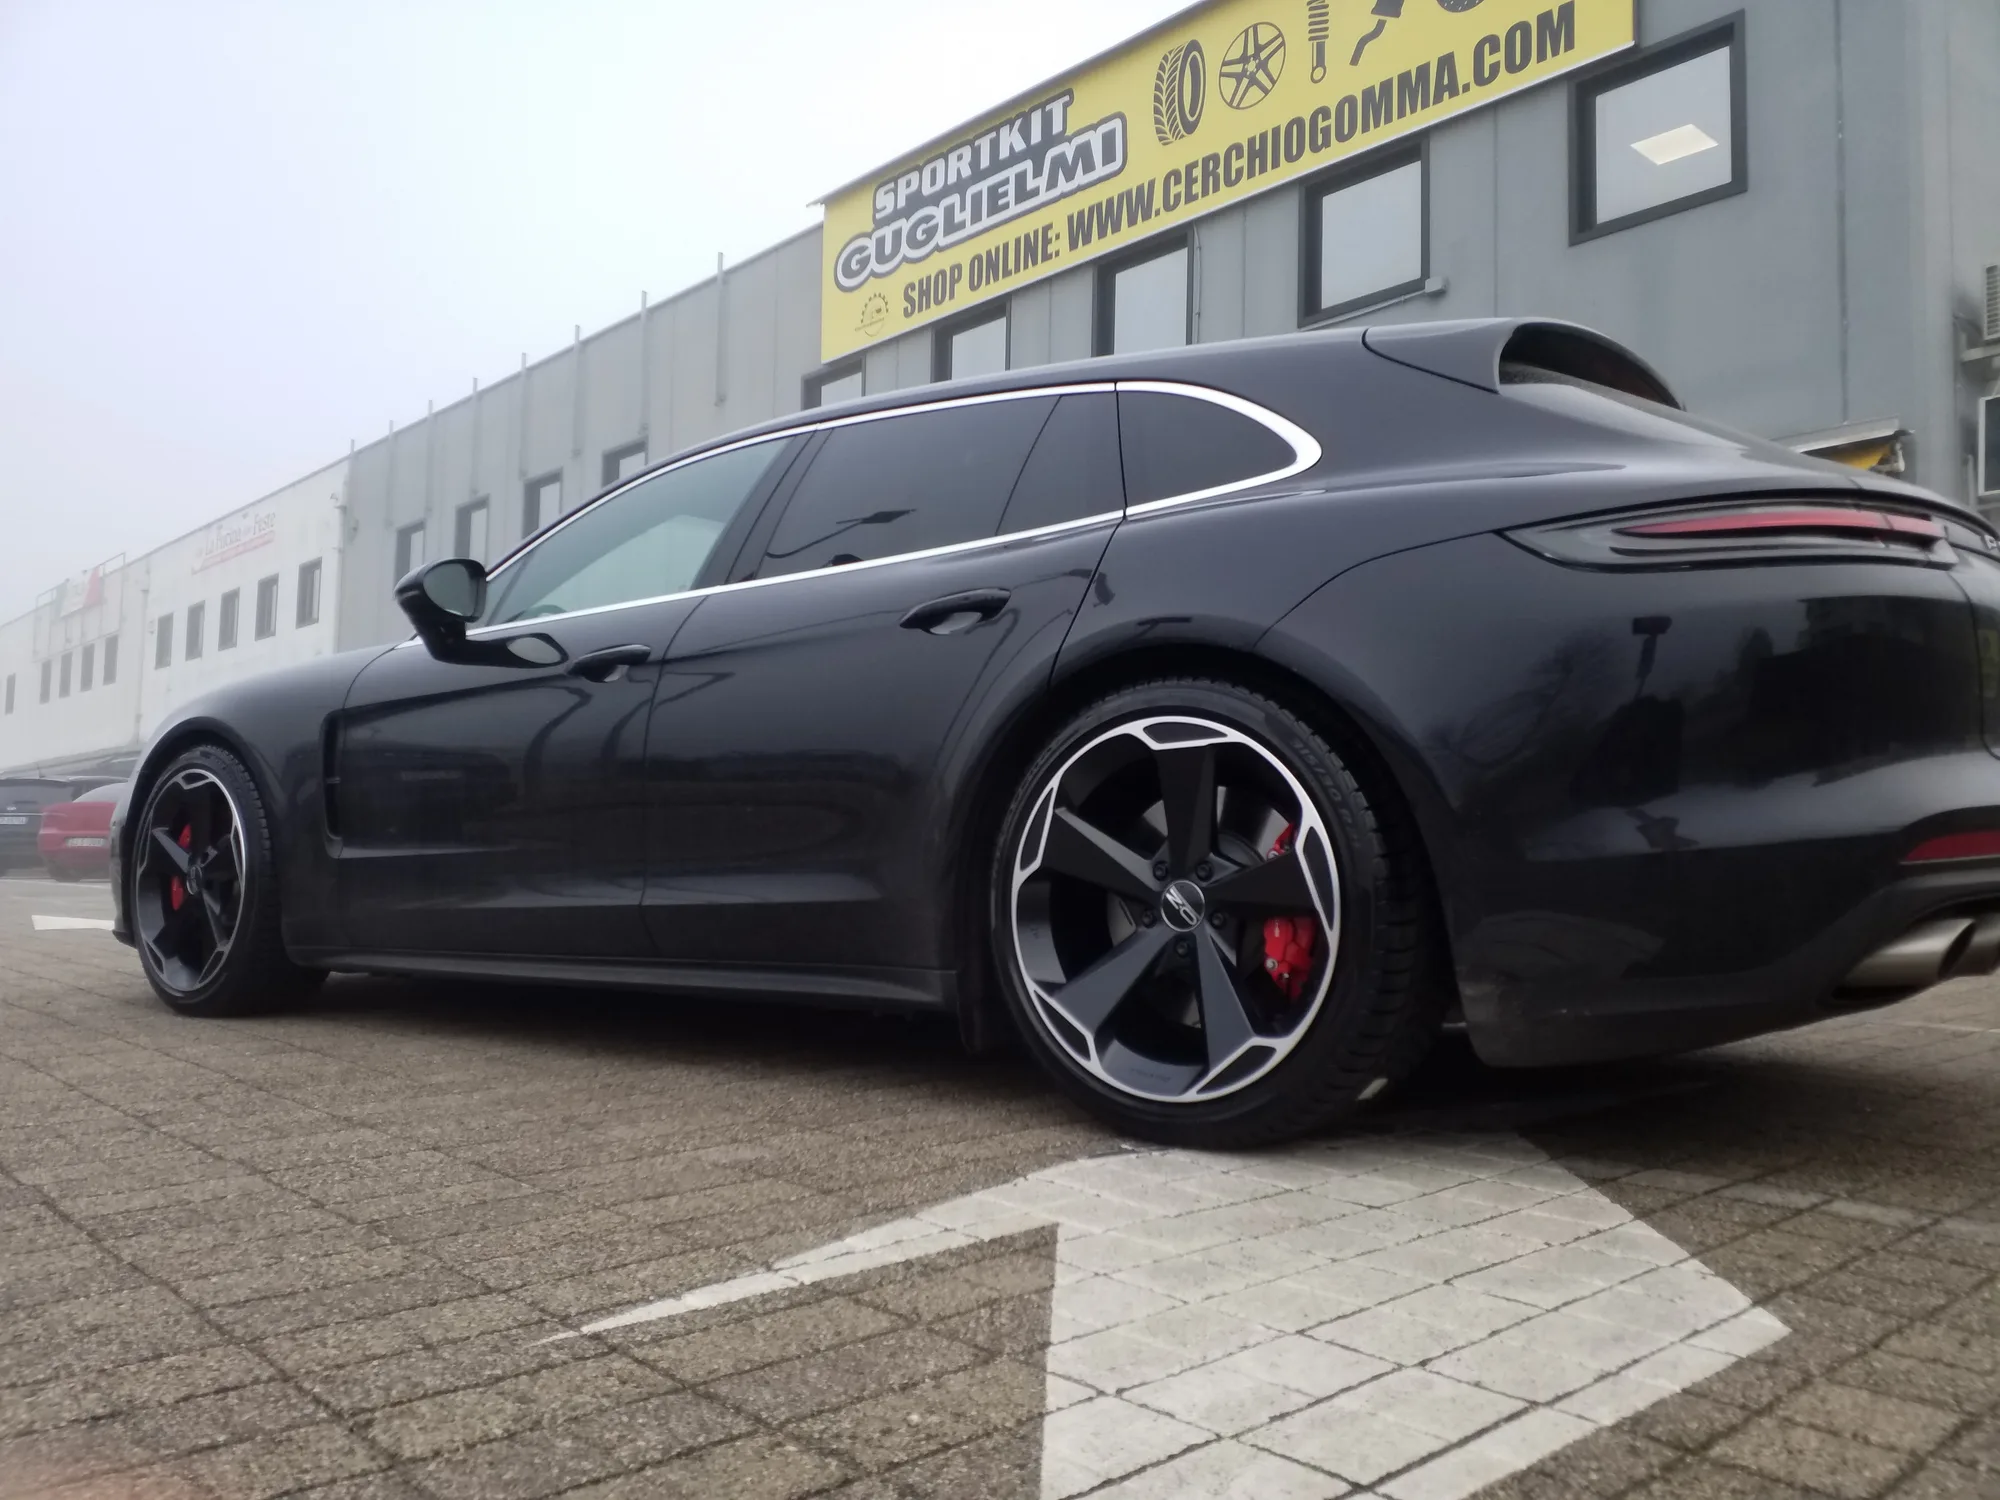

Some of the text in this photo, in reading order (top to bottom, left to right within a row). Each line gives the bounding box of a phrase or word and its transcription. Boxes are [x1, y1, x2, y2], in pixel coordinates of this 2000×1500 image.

[836, 116, 1124, 290] GUGLIELMI
[874, 94, 1071, 220] SPORTKIT
[903, 1, 1576, 318] SHOP ONLINE: WWW.CERCHIOGOMMA.COM
